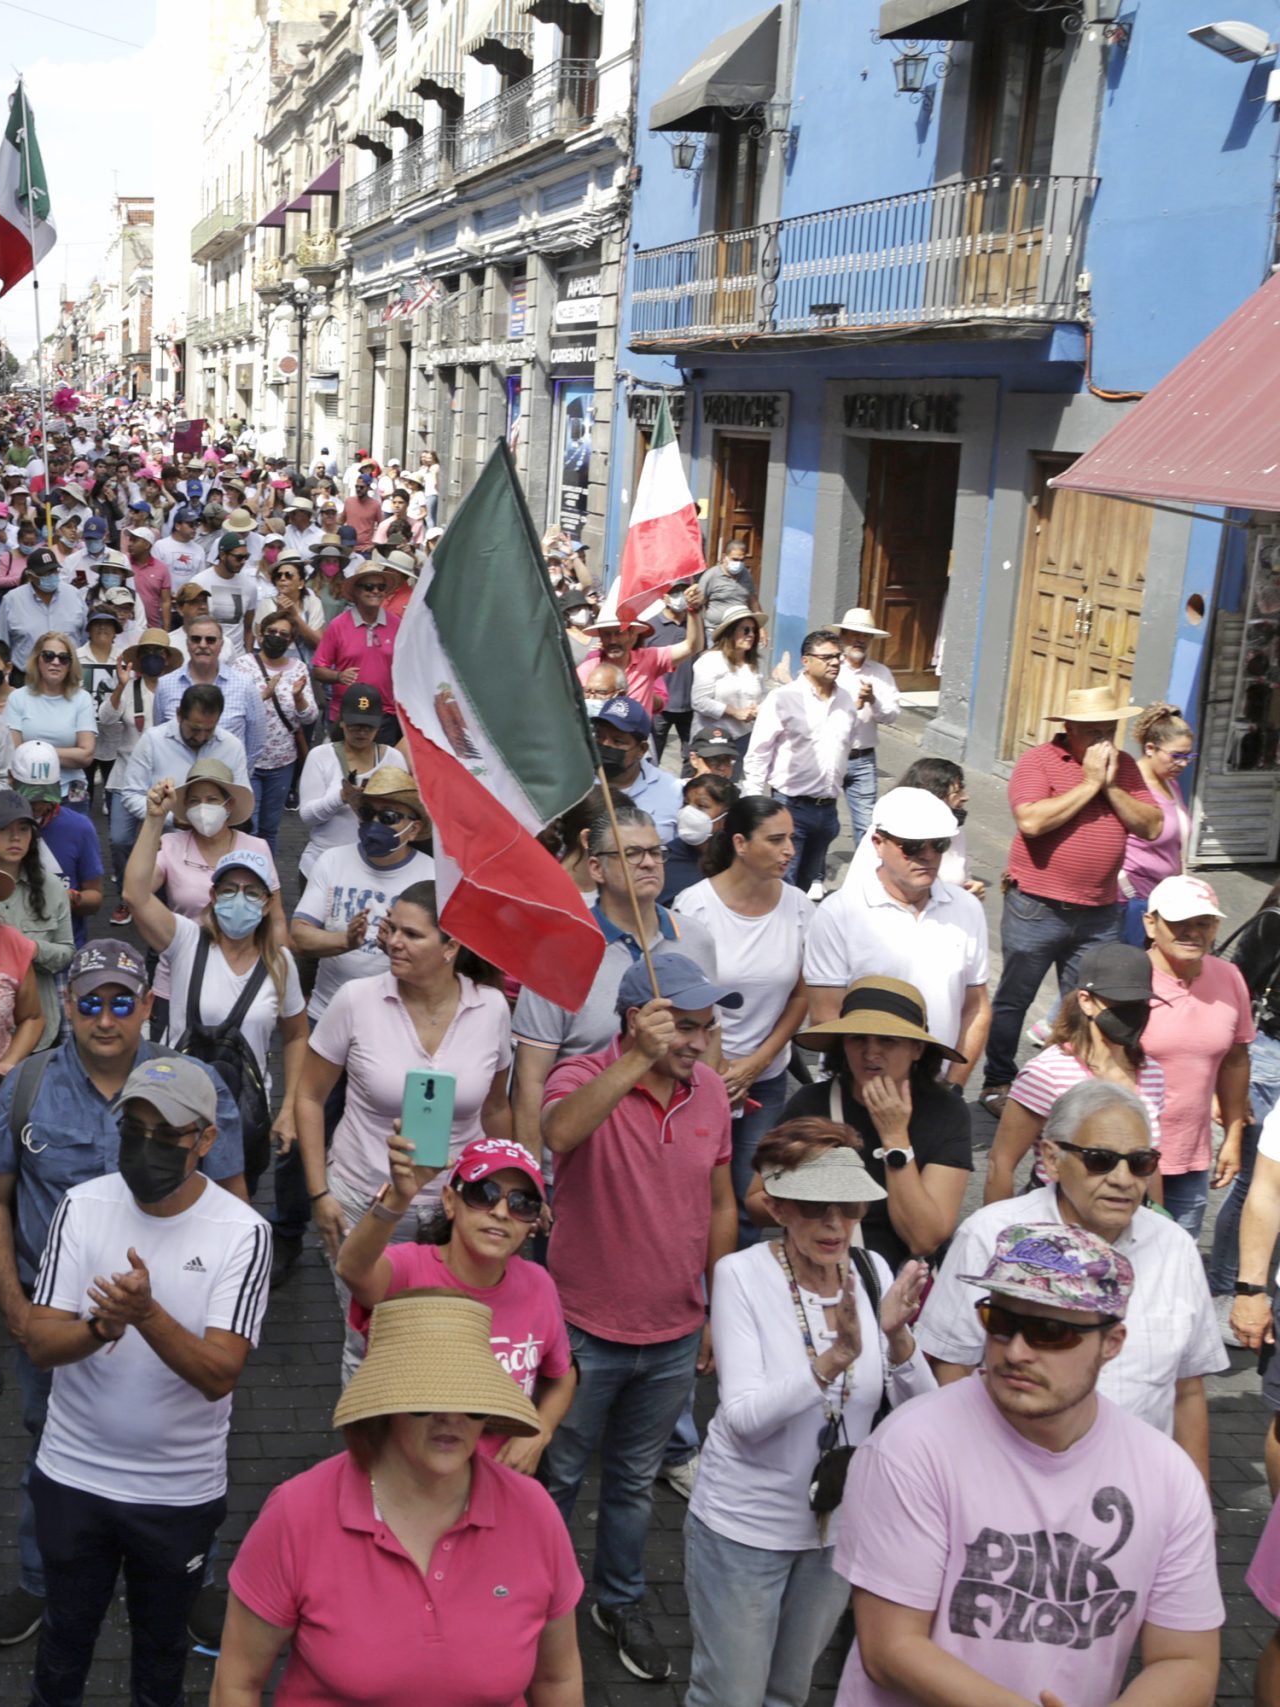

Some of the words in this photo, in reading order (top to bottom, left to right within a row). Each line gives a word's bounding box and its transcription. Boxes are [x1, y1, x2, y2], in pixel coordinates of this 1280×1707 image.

[843, 393, 962, 434] VERTICHE
[31, 761, 50, 779] LIV
[948, 1580, 1138, 1650] FLOYD
